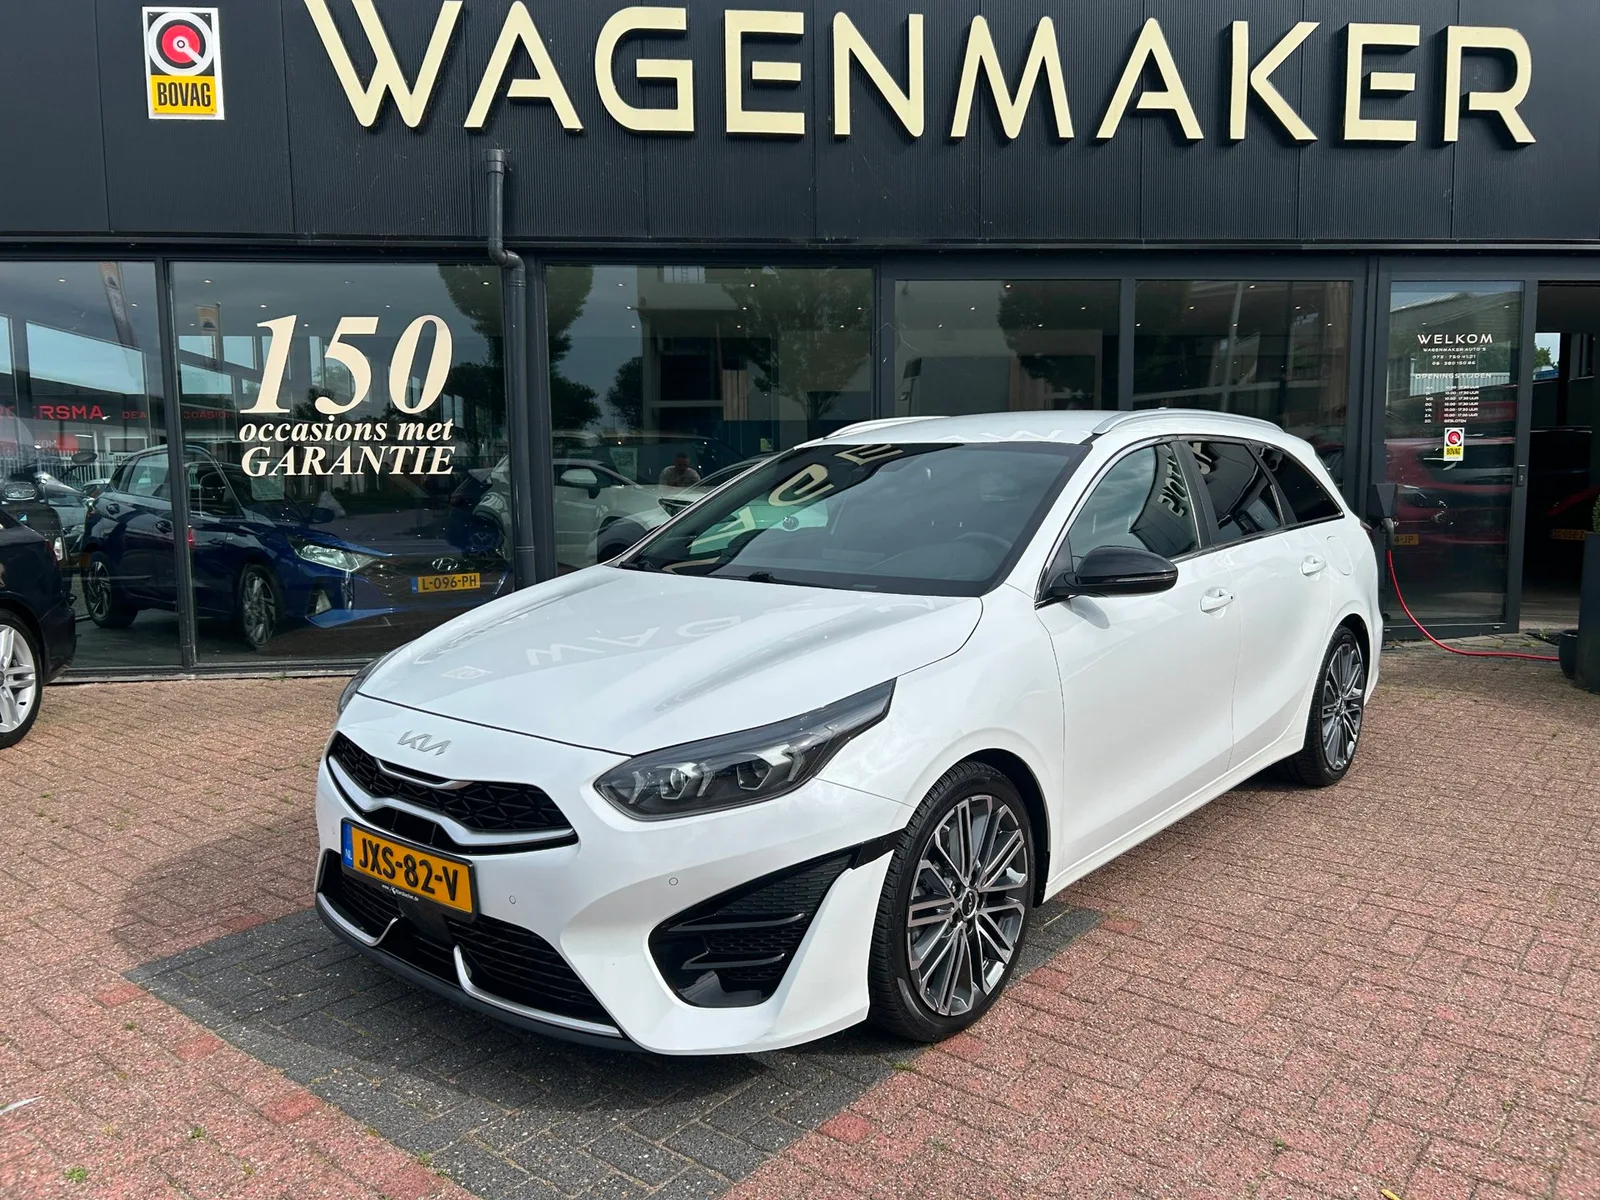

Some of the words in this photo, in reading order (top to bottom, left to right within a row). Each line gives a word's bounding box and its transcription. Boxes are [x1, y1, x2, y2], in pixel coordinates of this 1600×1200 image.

[308, 0, 1536, 143] WAGENMAKER
[157, 80, 212, 109] BOVAG
[1417, 333, 1493, 344] WELKOM
[239, 313, 453, 415] 150
[1415, 372, 1492, 380] OPENINGSTIJDEN
[239, 414, 387, 443] occasions
[398, 417, 454, 443] met
[240, 445, 456, 477] GARANTIE
[422, 575, 477, 590] L-096-PH
[397, 730, 452, 756] KIA
[359, 837, 459, 902] JXS-82-V
